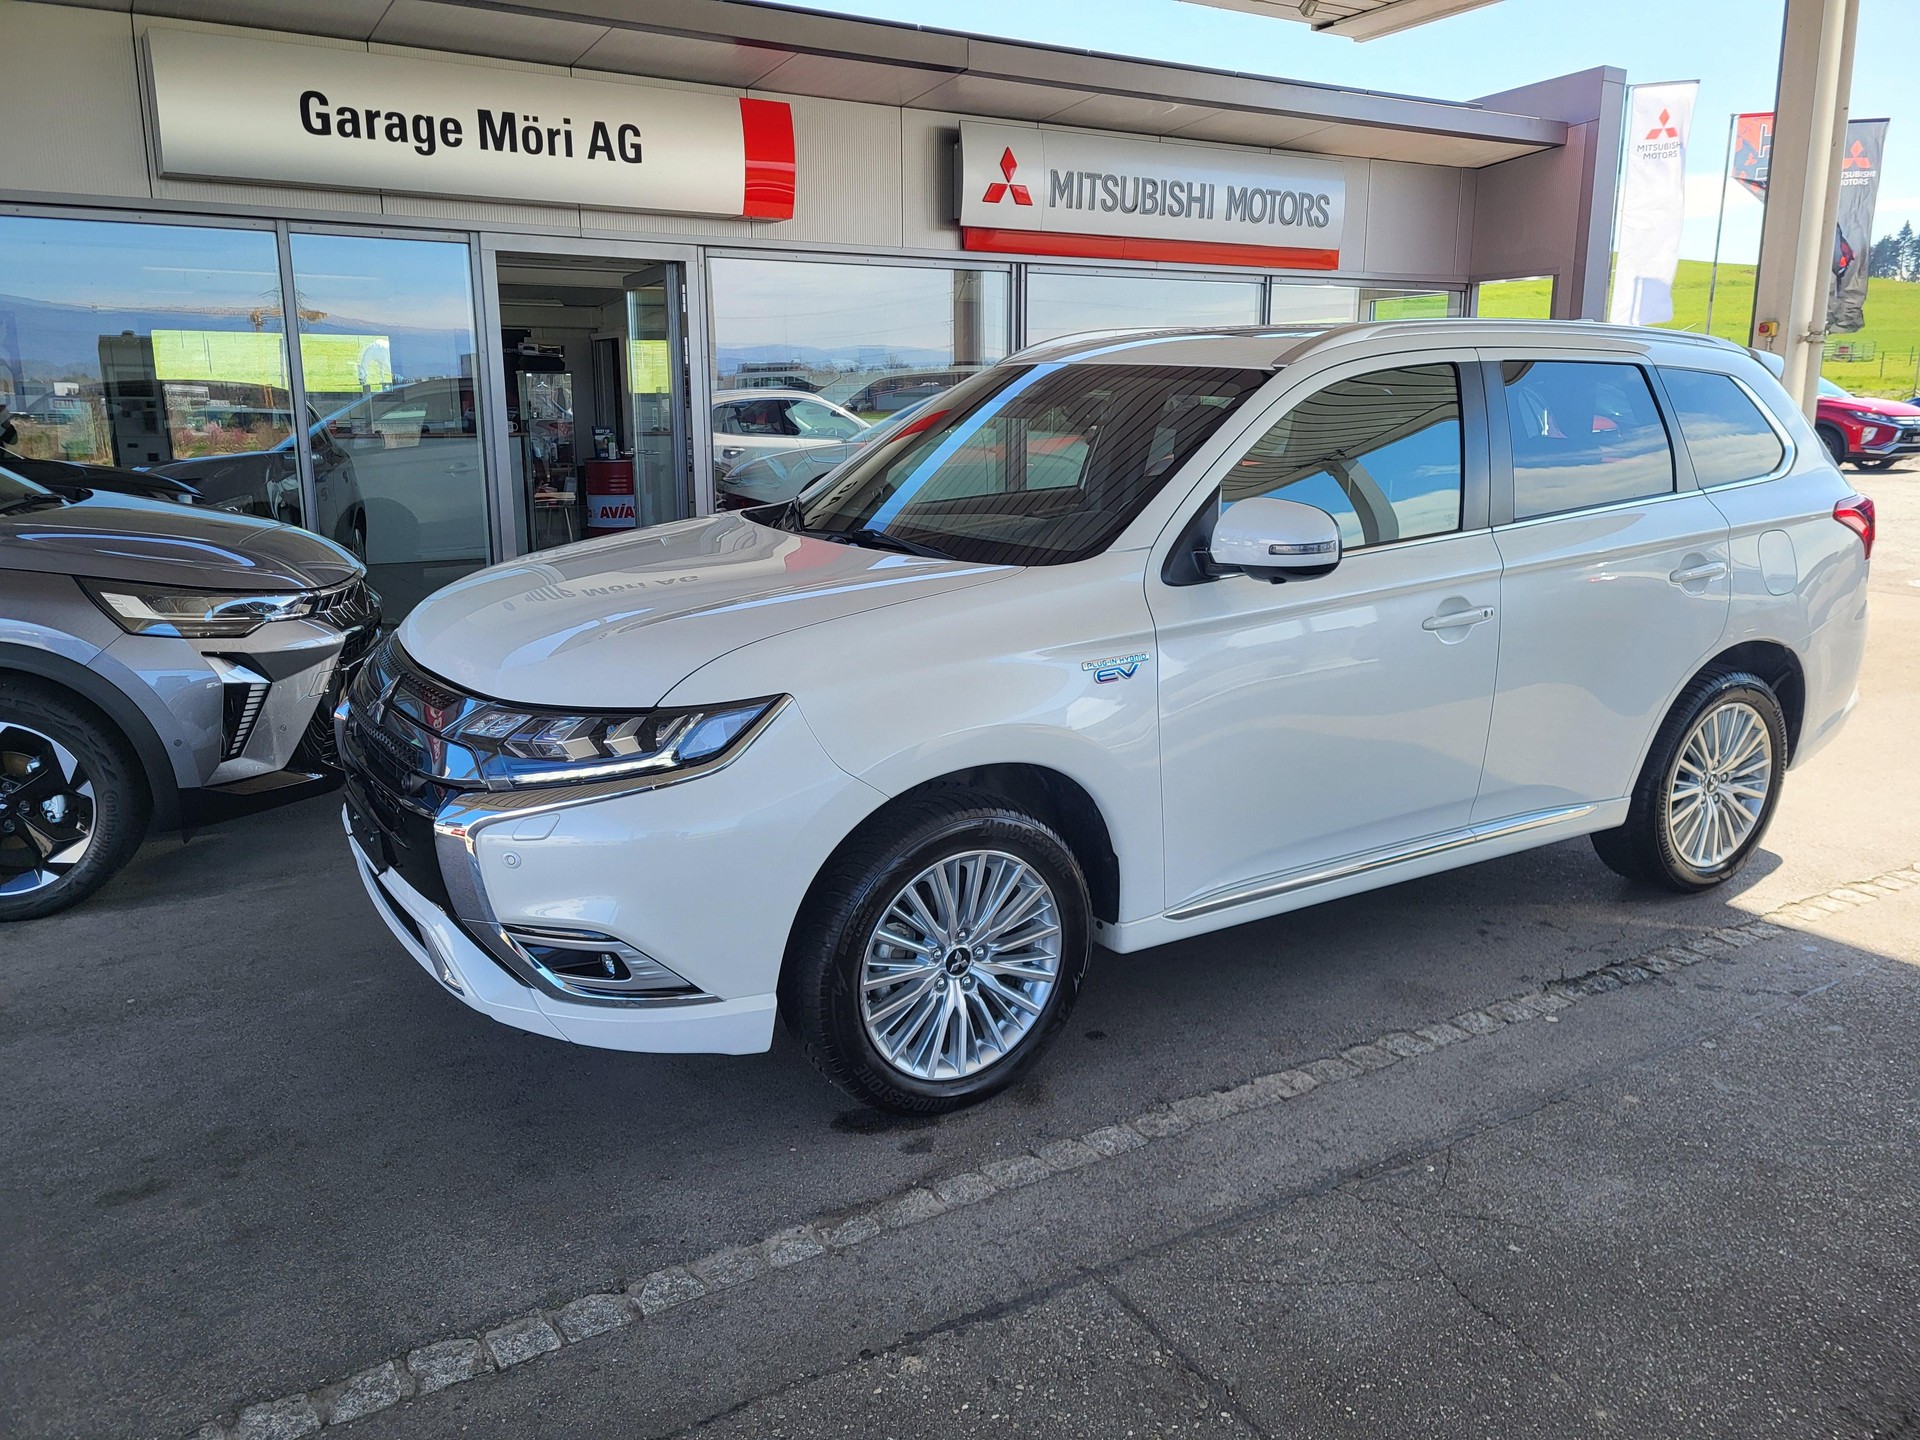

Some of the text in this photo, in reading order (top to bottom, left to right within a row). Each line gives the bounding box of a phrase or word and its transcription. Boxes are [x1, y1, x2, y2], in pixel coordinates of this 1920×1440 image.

[300, 90, 643, 164] Garage Möri AG
[1643, 150, 1678, 160] MOTORS
[1049, 168, 1331, 229] MITSUBISHI MOTORS
[1118, 653, 1147, 664] HYBRID
[1094, 663, 1140, 684] EV
